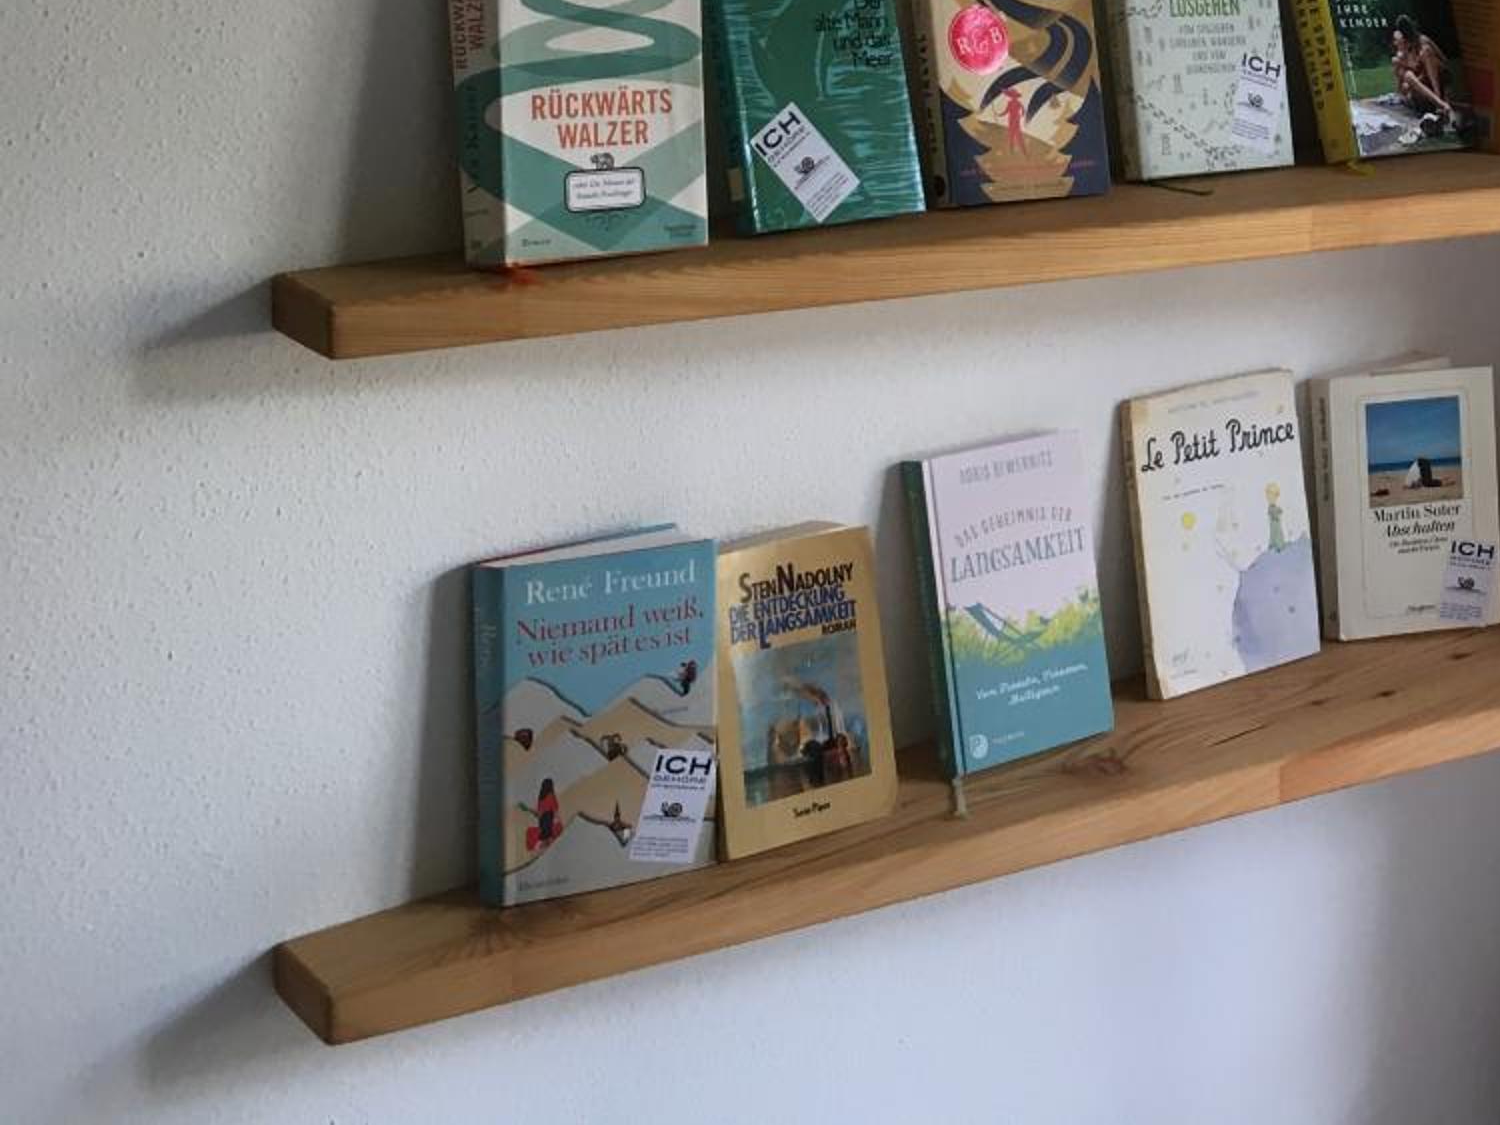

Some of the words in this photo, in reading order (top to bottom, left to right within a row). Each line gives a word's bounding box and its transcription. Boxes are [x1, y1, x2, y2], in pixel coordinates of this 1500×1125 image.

[1241, 51, 1281, 78] ICH
[531, 86, 673, 120] RÜCKWÄRTS
[557, 119, 650, 149] WALZER
[755, 111, 802, 157] ICH
[1140, 435, 1165, 473] Le
[1170, 427, 1221, 467] Petit
[1225, 416, 1296, 455] Prince
[1373, 506, 1421, 524] Martin
[949, 525, 1087, 584] LANGSAMKEIT
[1450, 540, 1496, 559] ICH
[525, 578, 593, 606] René
[603, 559, 696, 595] Freund
[516, 602, 637, 643] Niemand
[528, 641, 572, 667] wie
[579, 634, 629, 665] spät
[634, 634, 662, 653] es
[665, 629, 691, 646] ist
[655, 754, 712, 776] ICH
